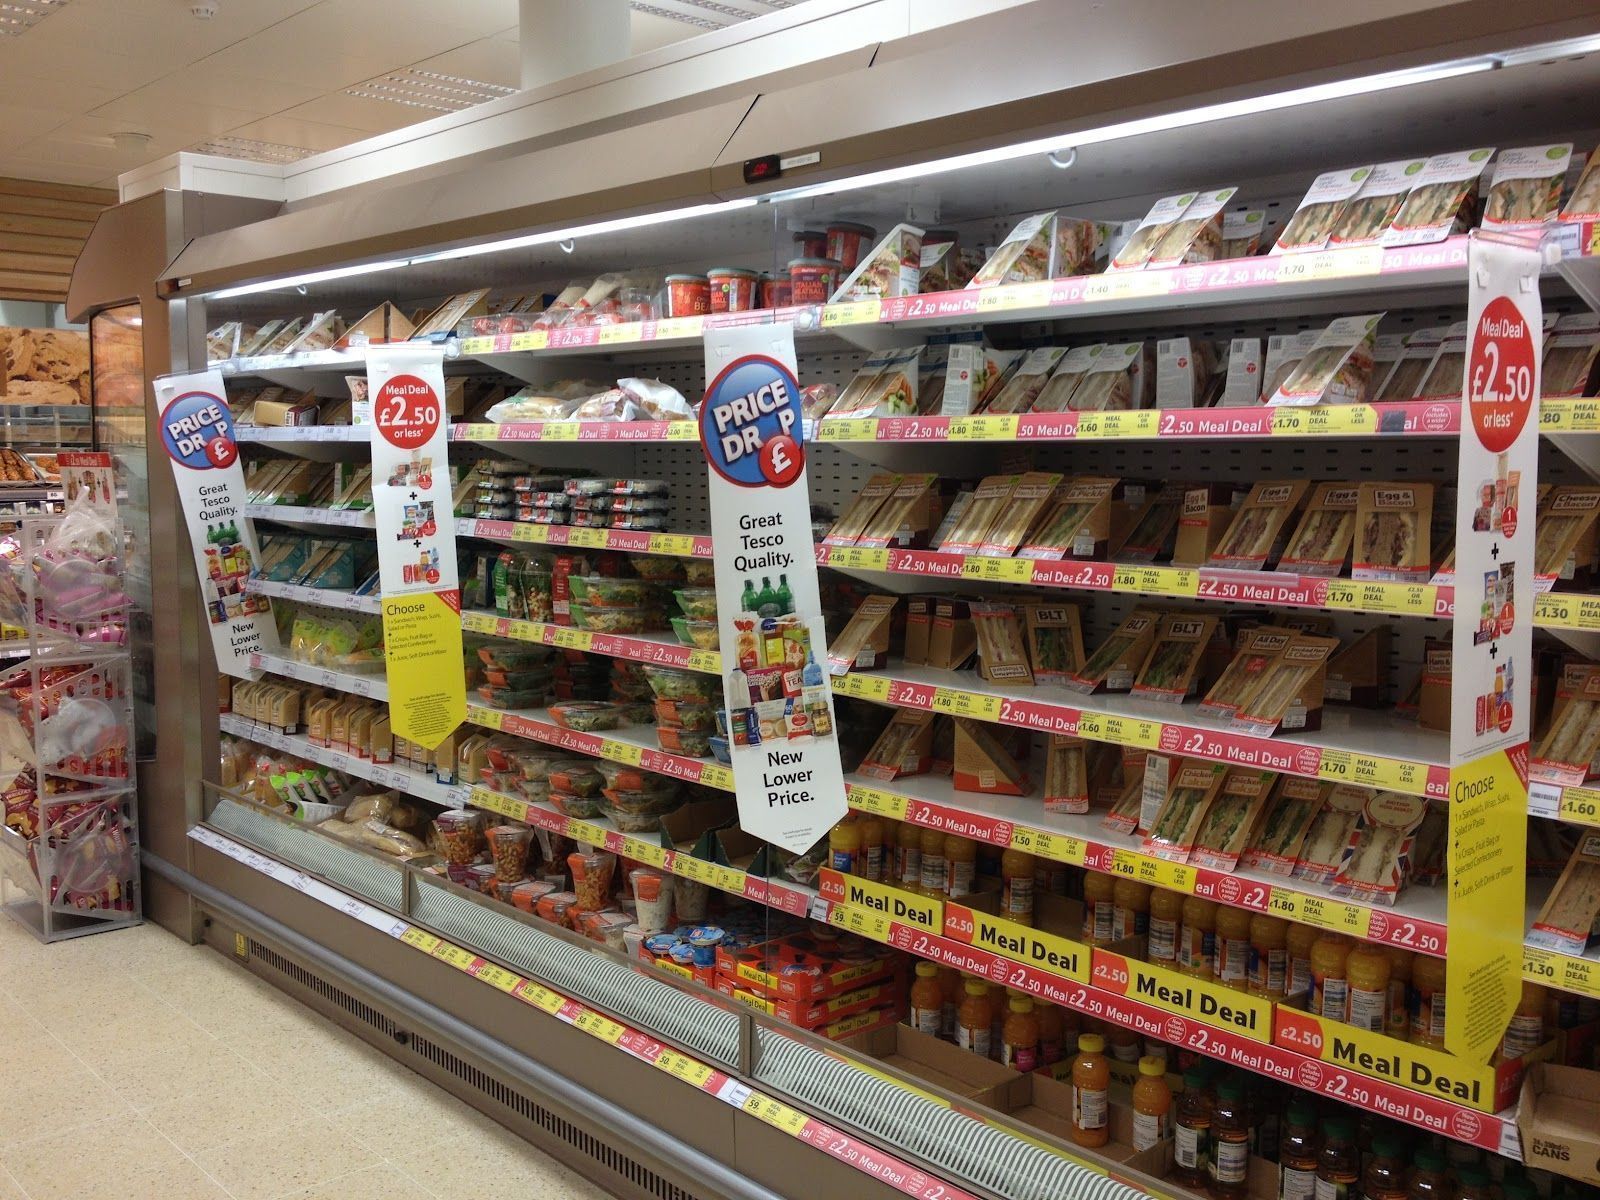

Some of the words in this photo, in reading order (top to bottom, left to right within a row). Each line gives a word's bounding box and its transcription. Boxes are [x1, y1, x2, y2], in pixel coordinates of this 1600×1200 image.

[1408, 252, 1445, 266] Meal
[1208, 269, 1248, 286] £2.50
[908, 300, 936, 316] £2.50
[939, 302, 960, 311] Meal
[1481, 317, 1501, 337] Meal
[1502, 319, 1523, 338] Deal
[1472, 342, 1531, 403] £2.50
[386, 385, 407, 395] Meal
[408, 385, 429, 394] Deal
[380, 396, 437, 426] £2.50
[712, 378, 789, 434] PRICE
[168, 404, 222, 440] PRICE
[1484, 413, 1493, 427] or
[1573, 412, 1597, 420] DEAL
[394, 430, 404, 438] or
[620, 430, 634, 438] Meal
[635, 430, 649, 438] Deal
[904, 422, 932, 438] £2.50
[1037, 424, 1062, 436] Meal
[1199, 420, 1228, 433] Meal
[1232, 420, 1262, 432] Deal
[199, 483, 228, 496] Great
[1377, 492, 1400, 500] Egg
[201, 497, 230, 508] Tesco
[1185, 504, 1206, 513] Bacon
[199, 506, 238, 521] Quality.
[739, 512, 783, 530] Great
[618, 538, 633, 548] Meal
[633, 539, 648, 549] Deal
[740, 534, 784, 550] Tesco
[734, 551, 794, 572] Quality.
[898, 555, 924, 571] £2.50
[927, 561, 949, 573] Meal
[1075, 567, 1109, 586] £2.50
[1199, 577, 1238, 597] £2.50
[1243, 586, 1275, 600] Meal
[1277, 588, 1308, 603] Deal
[1363, 593, 1383, 601] DEAL
[1365, 586, 1385, 594] MEAL
[386, 602, 425, 616] Choose
[1038, 609, 1064, 620] BLT
[1535, 607, 1568, 618] £1.30
[232, 622, 254, 635] New
[1126, 620, 1145, 630] BLT
[1172, 622, 1201, 634] BLT
[230, 632, 260, 647] Lower
[1269, 636, 1285, 645] Day
[234, 644, 262, 657] Price.
[653, 648, 672, 662] £2.50
[900, 687, 926, 704] £2.50
[1029, 714, 1053, 727] Meal
[1055, 718, 1078, 732] Deal
[1106, 726, 1121, 734] DEAL
[1107, 719, 1122, 727] MEAL
[1183, 734, 1222, 756] £2.50
[1227, 746, 1258, 763] Meal
[1262, 751, 1291, 769] Deal
[767, 752, 803, 767] New
[1358, 759, 1377, 768] MEAL
[663, 759, 683, 774] £2.50
[683, 767, 699, 779] Meal
[1183, 769, 1214, 779] Chicken
[1319, 762, 1346, 774] £1.70
[1356, 766, 1375, 776] DEAL
[763, 769, 813, 788] Lower
[1230, 775, 1261, 785] Chicken
[1455, 774, 1494, 804] Choose
[768, 790, 815, 807] Price.
[1562, 801, 1595, 816] £1.60
[915, 807, 943, 827] £2.50
[945, 819, 967, 833] Meal
[969, 823, 990, 839] Deal
[1140, 868, 1155, 877] DEAL
[1142, 861, 1157, 870] MEAL
[747, 887, 764, 900] Meal
[767, 893, 783, 906] Deal
[821, 881, 844, 895] £2.50
[851, 886, 889, 912] Meal
[894, 899, 933, 926] Deal
[1305, 899, 1324, 908] MEAL
[1270, 899, 1294, 912] £1.80
[1303, 906, 1322, 916] DEAL
[1391, 923, 1439, 950] £2.50
[946, 918, 973, 933] £2.50
[980, 923, 1025, 955] Meal
[1032, 941, 1078, 973] Deal
[913, 937, 941, 958] £2.50
[943, 950, 965, 966] Meal
[966, 958, 988, 974] Deal
[1522, 961, 1554, 977] £1.30
[1567, 961, 1591, 973] MEAL
[744, 969, 757, 981] Meal
[757, 973, 771, 984] Deal
[1565, 970, 1588, 982] DEAL
[1009, 969, 1040, 992] £2.50
[1044, 984, 1069, 1001] Meal
[1094, 965, 1127, 984] £2.50
[1136, 973, 1192, 1009] Meal
[1200, 993, 1256, 1030] Deal
[1069, 989, 1102, 1013] £2.50
[1106, 1006, 1132, 1024] Meal
[1135, 1016, 1161, 1034] Deal
[1188, 1030, 1226, 1056] £2.50
[1231, 1047, 1261, 1068] Meal
[1264, 1059, 1294, 1079] Deal
[1281, 1026, 1322, 1049] £2.50
[1333, 1037, 1400, 1078] Meal
[1411, 1061, 1480, 1103] Deal
[1325, 1075, 1368, 1103] £2.50
[1374, 1095, 1409, 1118] Meal
[1413, 1107, 1447, 1130] Deal
[1532, 1145, 1570, 1161] CANS
[828, 1139, 858, 1161] £2.50
[858, 1155, 881, 1172] Meal
[882, 1167, 905, 1185] Deal
